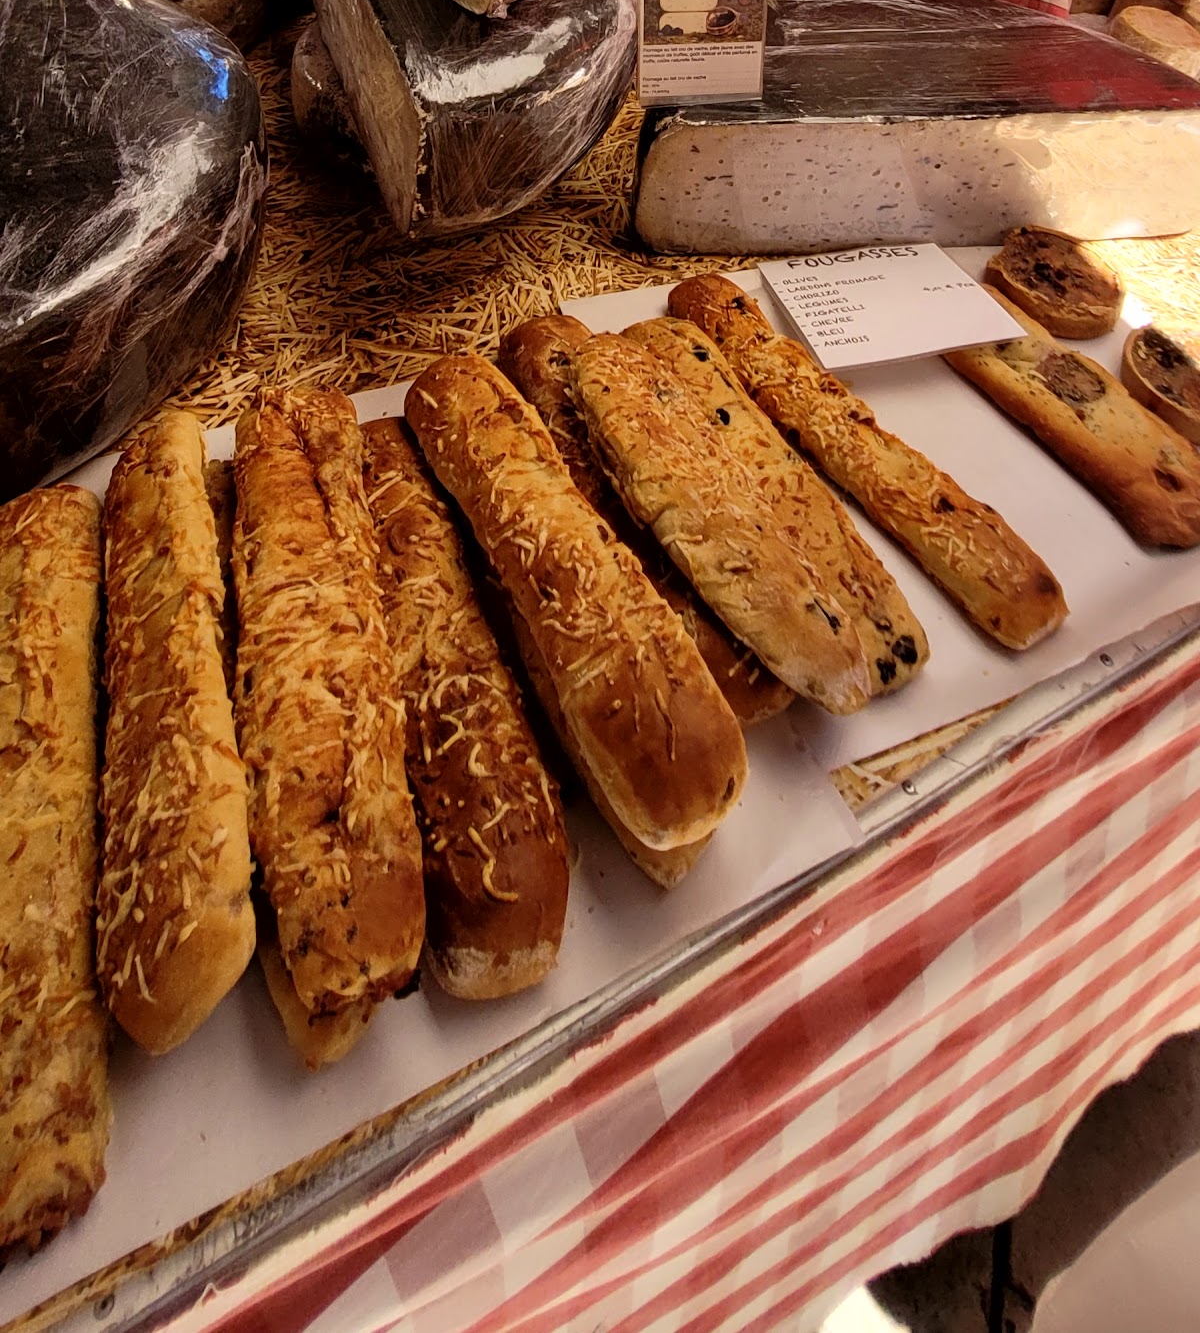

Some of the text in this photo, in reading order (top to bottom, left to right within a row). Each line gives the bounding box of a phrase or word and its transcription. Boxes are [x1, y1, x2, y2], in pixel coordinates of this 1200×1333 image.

[787, 246, 918, 270] FOUGASSES
[782, 276, 818, 285] OLIVES
[787, 275, 886, 293] LARDONS FROMAGE
[793, 290, 840, 301] CHORIZO
[798, 297, 848, 309] LEGUMES
[805, 304, 866, 318] FIGATELLI
[811, 316, 854, 327] CHEVRE
[816, 328, 845, 337] BLEU
[824, 335, 870, 347] ANCHOIS
